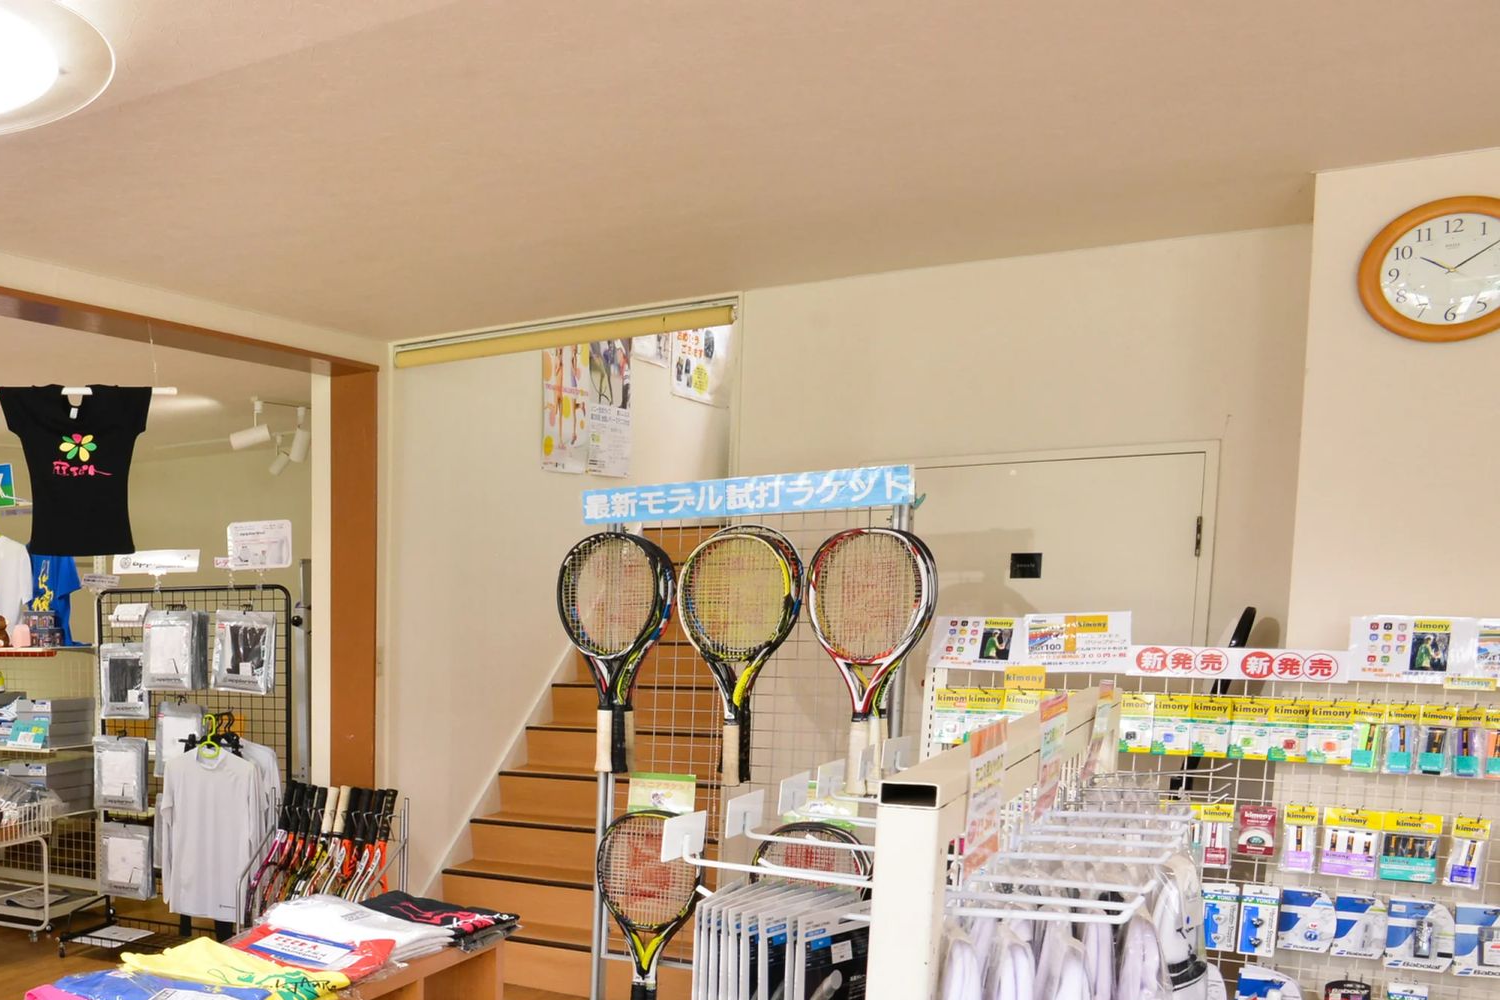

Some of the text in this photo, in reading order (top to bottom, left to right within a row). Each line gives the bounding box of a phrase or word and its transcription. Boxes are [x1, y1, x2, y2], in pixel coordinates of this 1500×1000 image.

[1444, 218, 1464, 234] 12
[1416, 227, 1432, 243] 11
[1394, 245, 1414, 261] 10
[1388, 267, 1400, 284] 9
[1396, 288, 1408, 304] 8
[1476, 296, 1488, 314] 5
[1444, 305, 1457, 322] 6
[584, 470, 911, 521] 最新モデル試打ラケット
[983, 619, 1014, 628] kimony
[1413, 621, 1450, 632] kimony
[1137, 647, 1334, 678] 新発売 新発売
[1006, 672, 1044, 684] kimony
[969, 694, 1002, 705] kimony
[1006, 695, 1040, 705] kimony
[1194, 702, 1229, 713] kimony
[1233, 703, 1270, 715] kimony
[1274, 704, 1310, 717] kimony
[1312, 706, 1352, 719] kimony
[1353, 709, 1383, 719] kimony
[1388, 711, 1417, 721] kimony
[1422, 711, 1453, 721] kimony
[1203, 810, 1232, 819] kimony
[1244, 811, 1274, 821] kimony
[1286, 813, 1316, 822] kimony
[1338, 815, 1368, 826] kimony
[1396, 819, 1422, 829] kimon
[1346, 950, 1374, 958] Babolat
[1402, 960, 1442, 970] Babolat
[1332, 988, 1370, 997] Babolat
